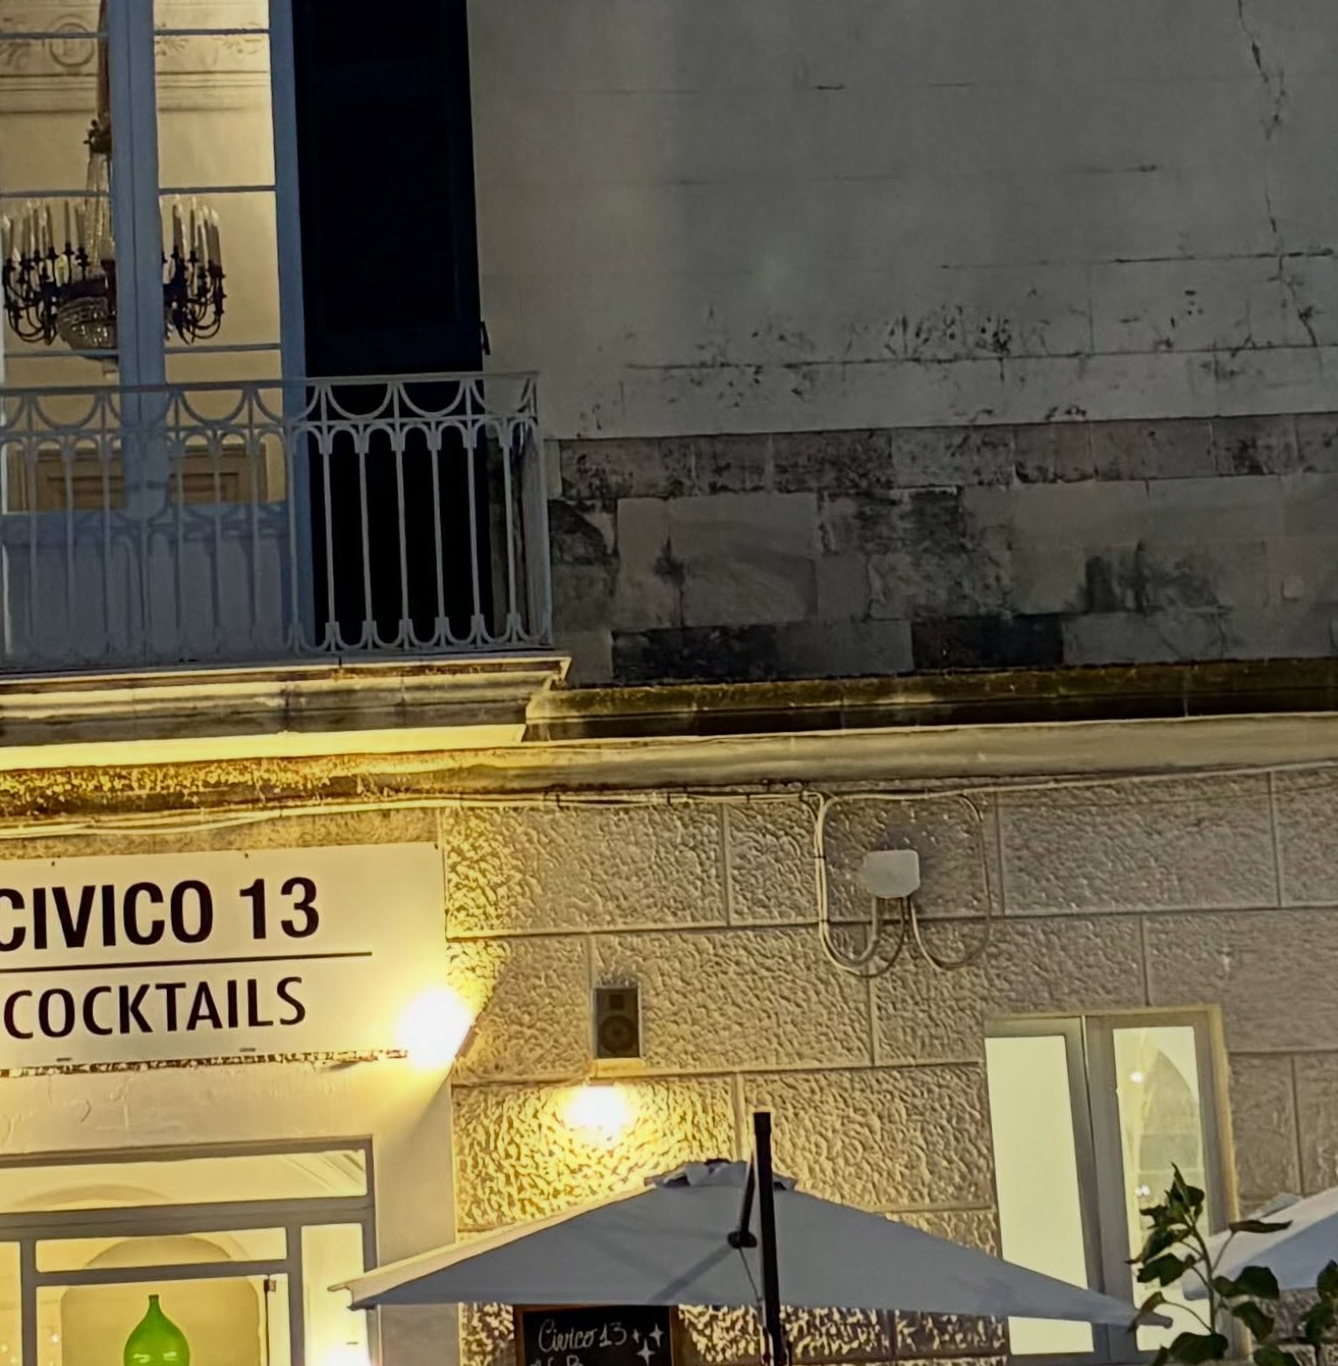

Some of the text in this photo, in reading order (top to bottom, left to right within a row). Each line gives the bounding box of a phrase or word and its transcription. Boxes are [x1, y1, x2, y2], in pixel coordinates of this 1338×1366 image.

[239, 877, 320, 940] 13
[4, 976, 306, 1039] COCKTAILS
[599, 1321, 627, 1348] 13
